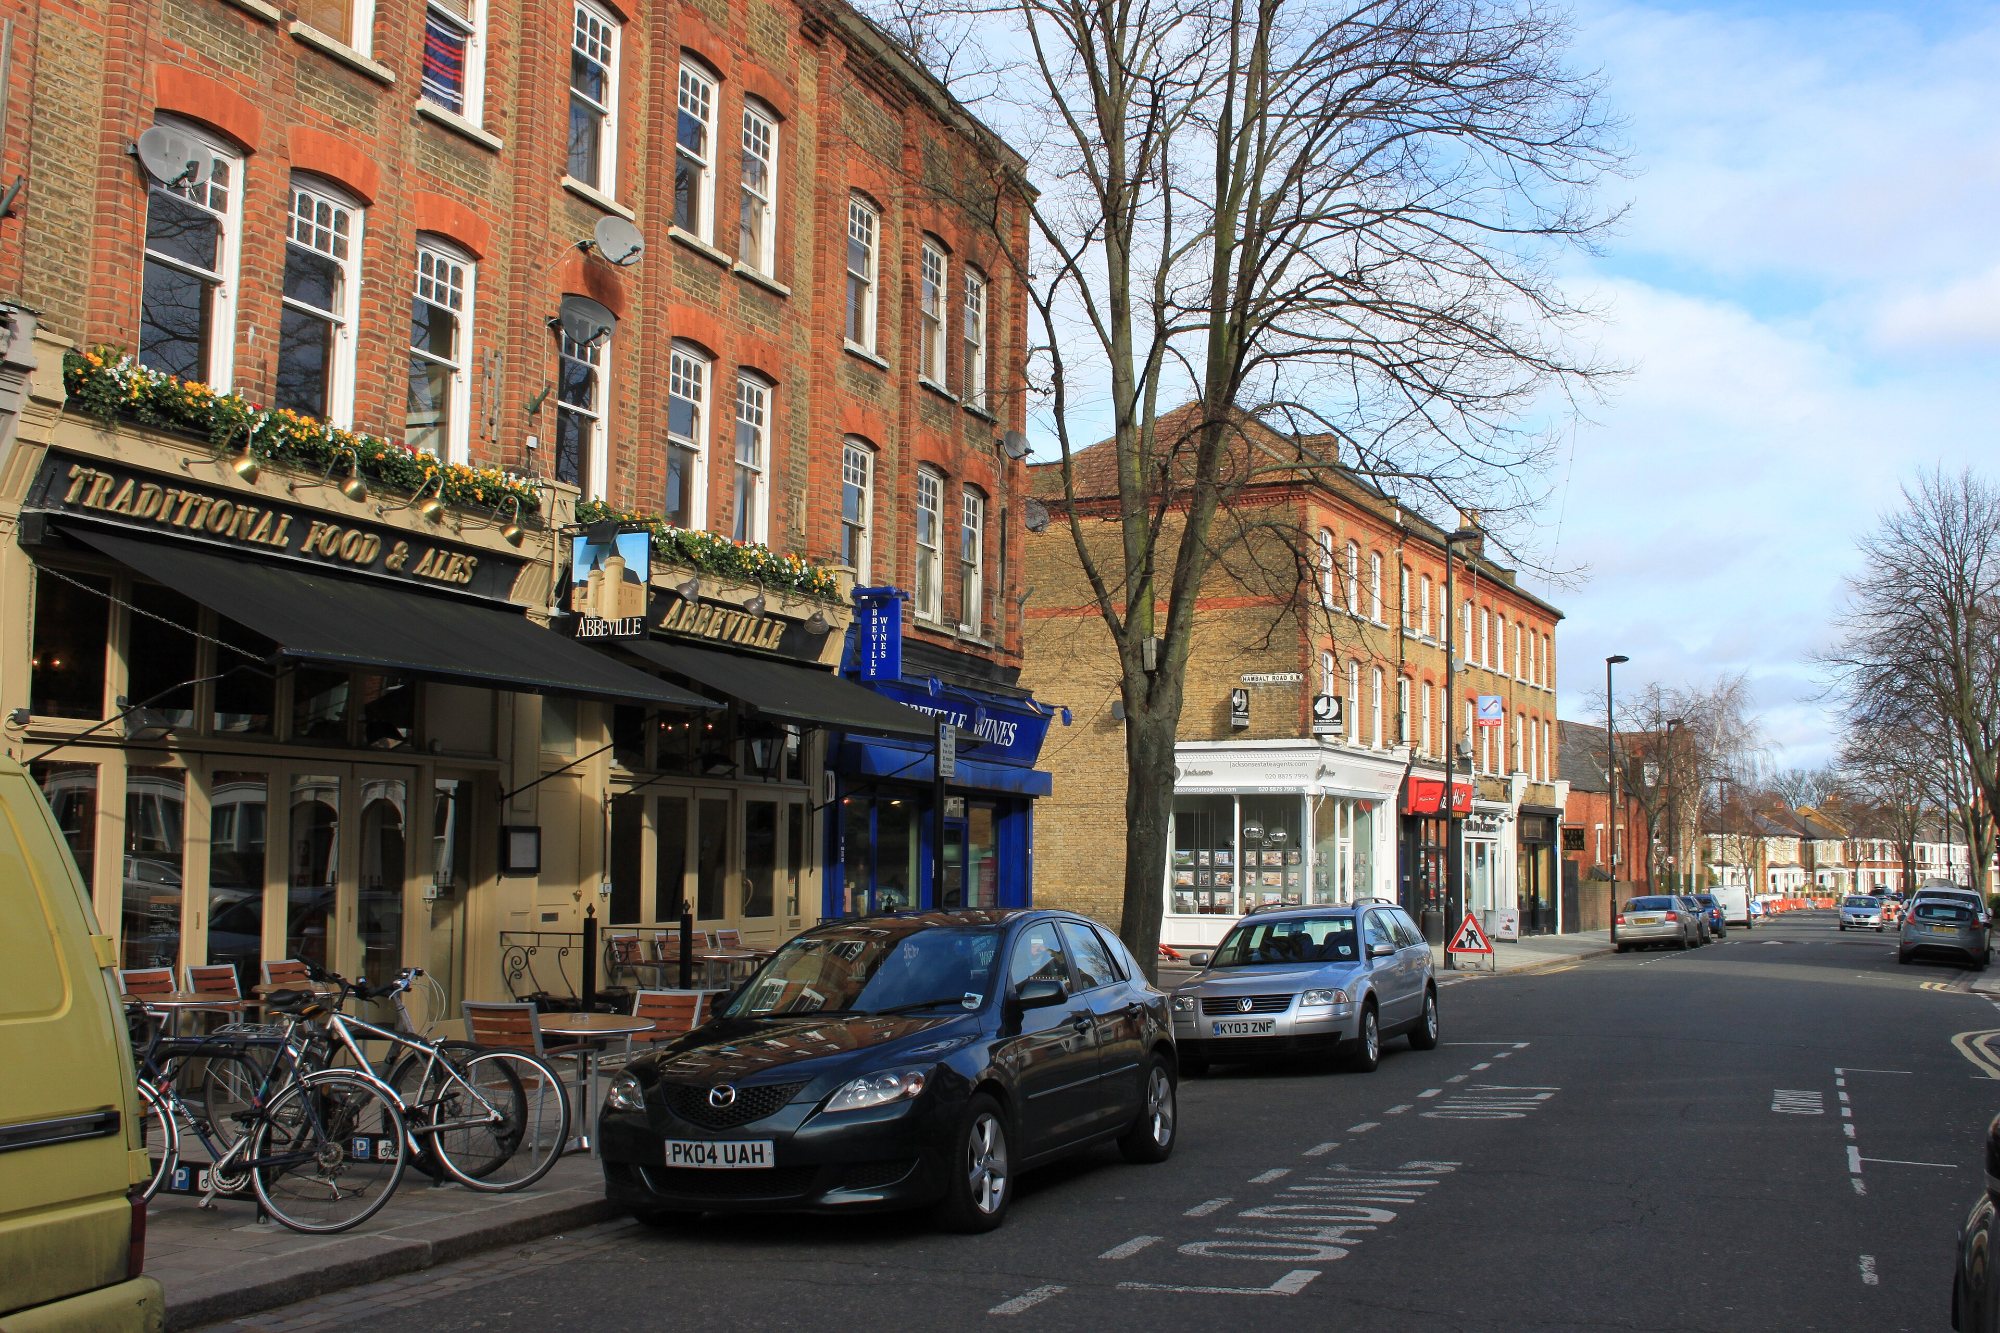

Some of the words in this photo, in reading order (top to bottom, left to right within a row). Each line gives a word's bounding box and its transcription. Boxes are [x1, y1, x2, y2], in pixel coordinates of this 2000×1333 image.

[64, 464, 293, 547] TRADITIONAL
[300, 520, 382, 565] FOOD
[385, 541, 409, 572] &
[412, 547, 478, 584] ALES
[576, 617, 641, 637] ABBEVILLE
[659, 598, 787, 650] ABBEVILLE
[870, 601, 878, 676] ABBEVILLE
[879, 617, 888, 659] WINES
[974, 718, 1017, 747] WINES
[1220, 1022, 1249, 1034] KY03
[1251, 1021, 1273, 1033] ZNF
[1419, 1084, 1561, 1119] ONLY
[357, 1140, 366, 1156] P
[672, 1143, 717, 1164] PK04
[723, 1143, 764, 1164] UAH
[175, 1169, 186, 1187] P
[1116, 1160, 1463, 1295] LOADING
